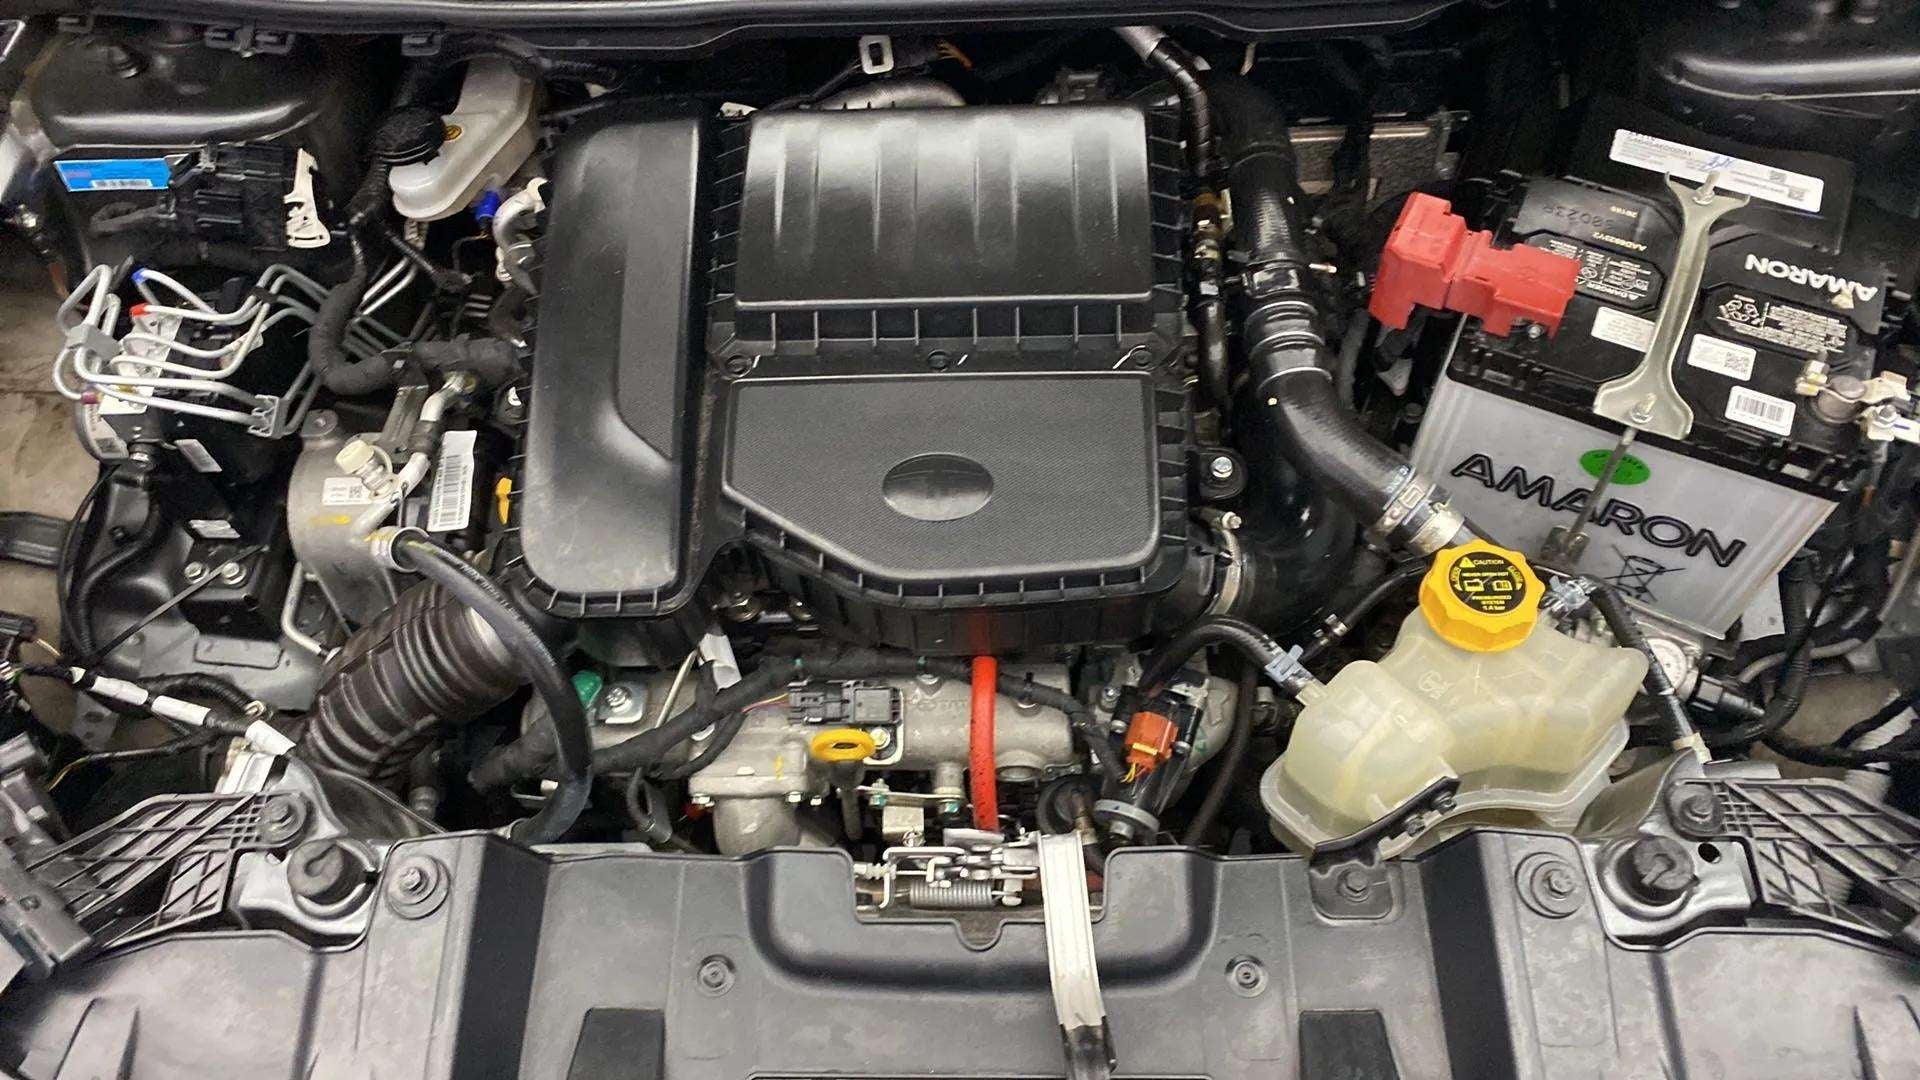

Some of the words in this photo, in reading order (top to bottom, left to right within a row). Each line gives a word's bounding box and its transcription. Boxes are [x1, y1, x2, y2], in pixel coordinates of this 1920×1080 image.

[1586, 281, 1628, 299] DANGER
[1744, 253, 1879, 301] AMARON
[1450, 453, 1747, 568] AMARON
